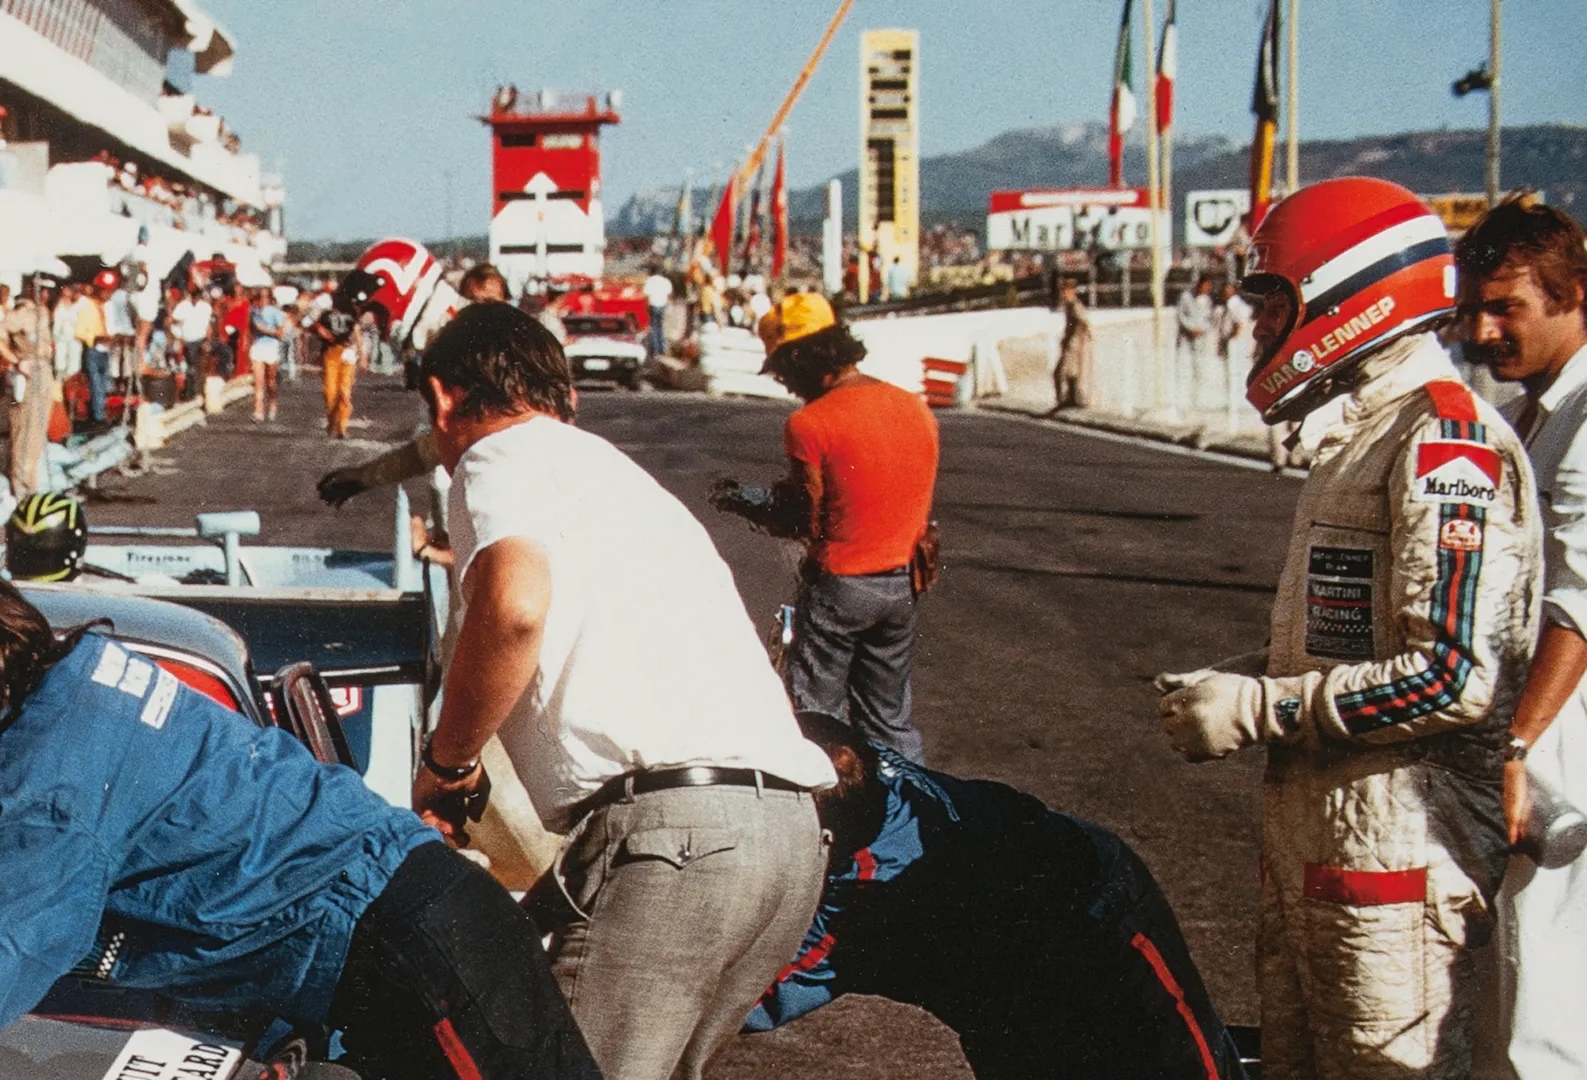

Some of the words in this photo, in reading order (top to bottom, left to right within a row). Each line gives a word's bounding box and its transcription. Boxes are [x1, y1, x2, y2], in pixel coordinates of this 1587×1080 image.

[1011, 216, 1150, 247] Marro
[1261, 364, 1299, 394] VAN
[1311, 296, 1396, 360] LENNEP
[1423, 477, 1495, 501] Marlboro
